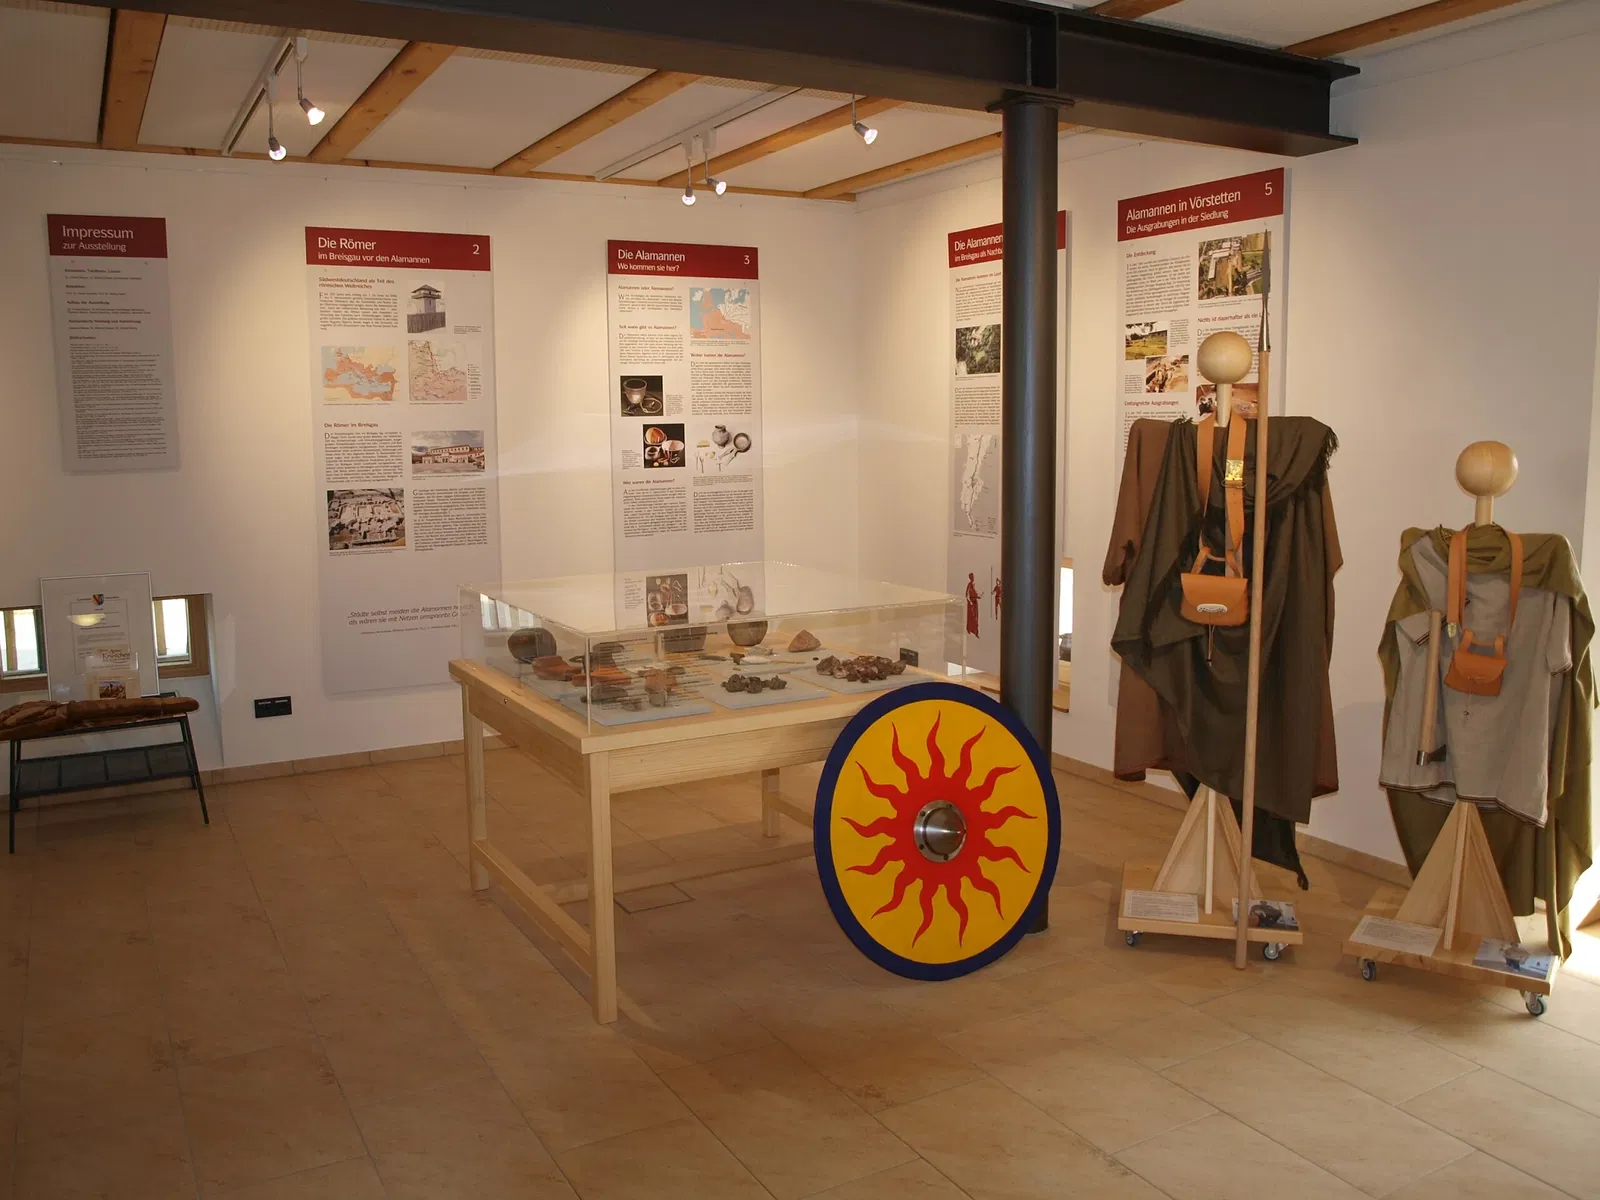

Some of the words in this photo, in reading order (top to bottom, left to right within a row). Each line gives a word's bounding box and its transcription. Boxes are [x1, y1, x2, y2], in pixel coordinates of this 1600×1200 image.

[1264, 182, 1273, 196] 5
[1126, 203, 1177, 221] Alamannen
[1178, 200, 1188, 212] in
[1189, 190, 1241, 210] Vörstetten
[1126, 225, 1137, 235] Die
[1137, 218, 1181, 233] Ausgrabungen
[1181, 216, 1188, 225] in
[1188, 214, 1200, 224] der
[1200, 209, 1229, 222] Siedlung
[62, 225, 134, 240] Impressum
[79, 242, 128, 253] Ausstellung
[318, 237, 337, 249] Die
[340, 237, 377, 251] Römer
[472, 244, 480, 255] 2
[954, 240, 966, 252] Die
[967, 234, 1003, 249] Alamannen
[318, 252, 328, 260] im
[329, 252, 361, 263] Breisgau
[362, 254, 375, 262] vor
[376, 253, 390, 262] den
[391, 254, 431, 264] Alamannen
[618, 249, 634, 261] Die
[635, 249, 686, 263] Alamannen
[744, 255, 751, 265] 3
[954, 254, 961, 262] im
[961, 252, 980, 262] Breisgau
[618, 262, 630, 271] Wo
[630, 262, 656, 272] kommen
[657, 263, 666, 272] sie
[666, 263, 681, 273] her?
